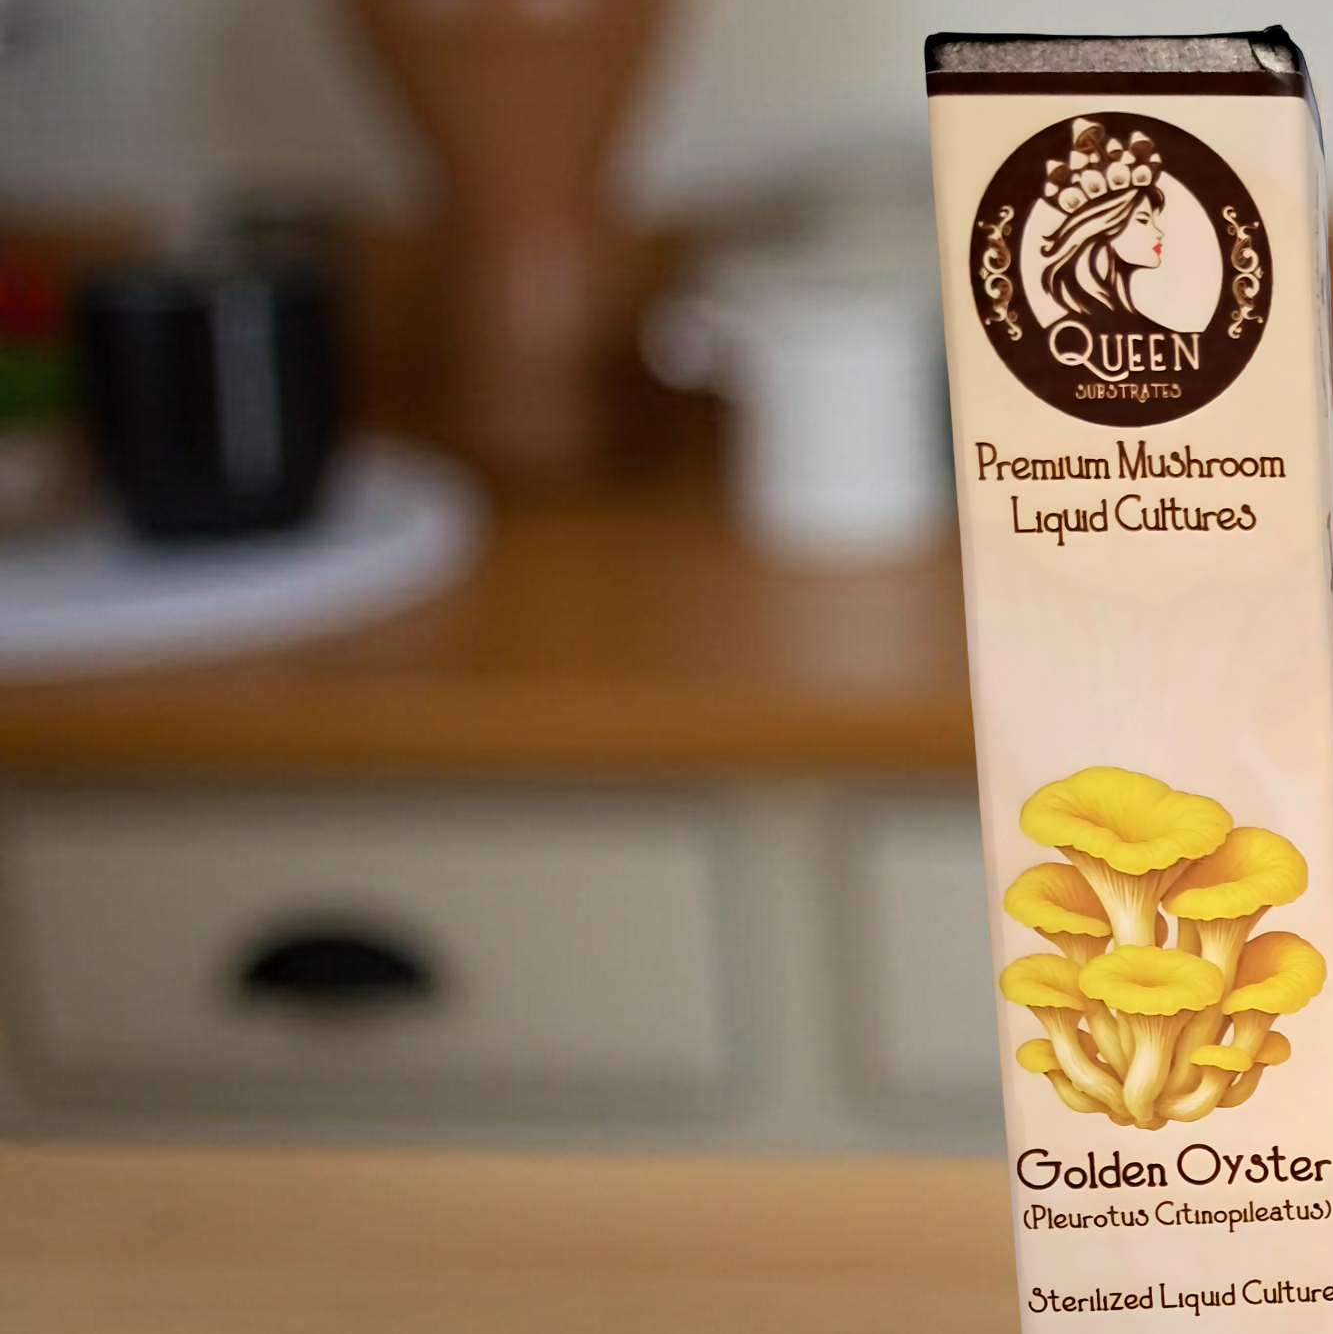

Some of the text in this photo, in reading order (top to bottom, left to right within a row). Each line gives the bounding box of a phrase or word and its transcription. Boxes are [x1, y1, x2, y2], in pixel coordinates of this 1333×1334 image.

[1049, 320, 1201, 383] QUEEN
[1075, 384, 1181, 404] SUBSTRATES
[975, 440, 1286, 481] Premium Mushroom
[1011, 494, 1256, 546] Liquid Cultures
[1017, 1144, 1332, 1190] Golden Oyster
[1024, 1200, 1331, 1233] (Pleurotus Citinopileatus)
[1028, 1287, 1153, 1313] Sterilized
[1159, 1283, 1235, 1316] Liquid
